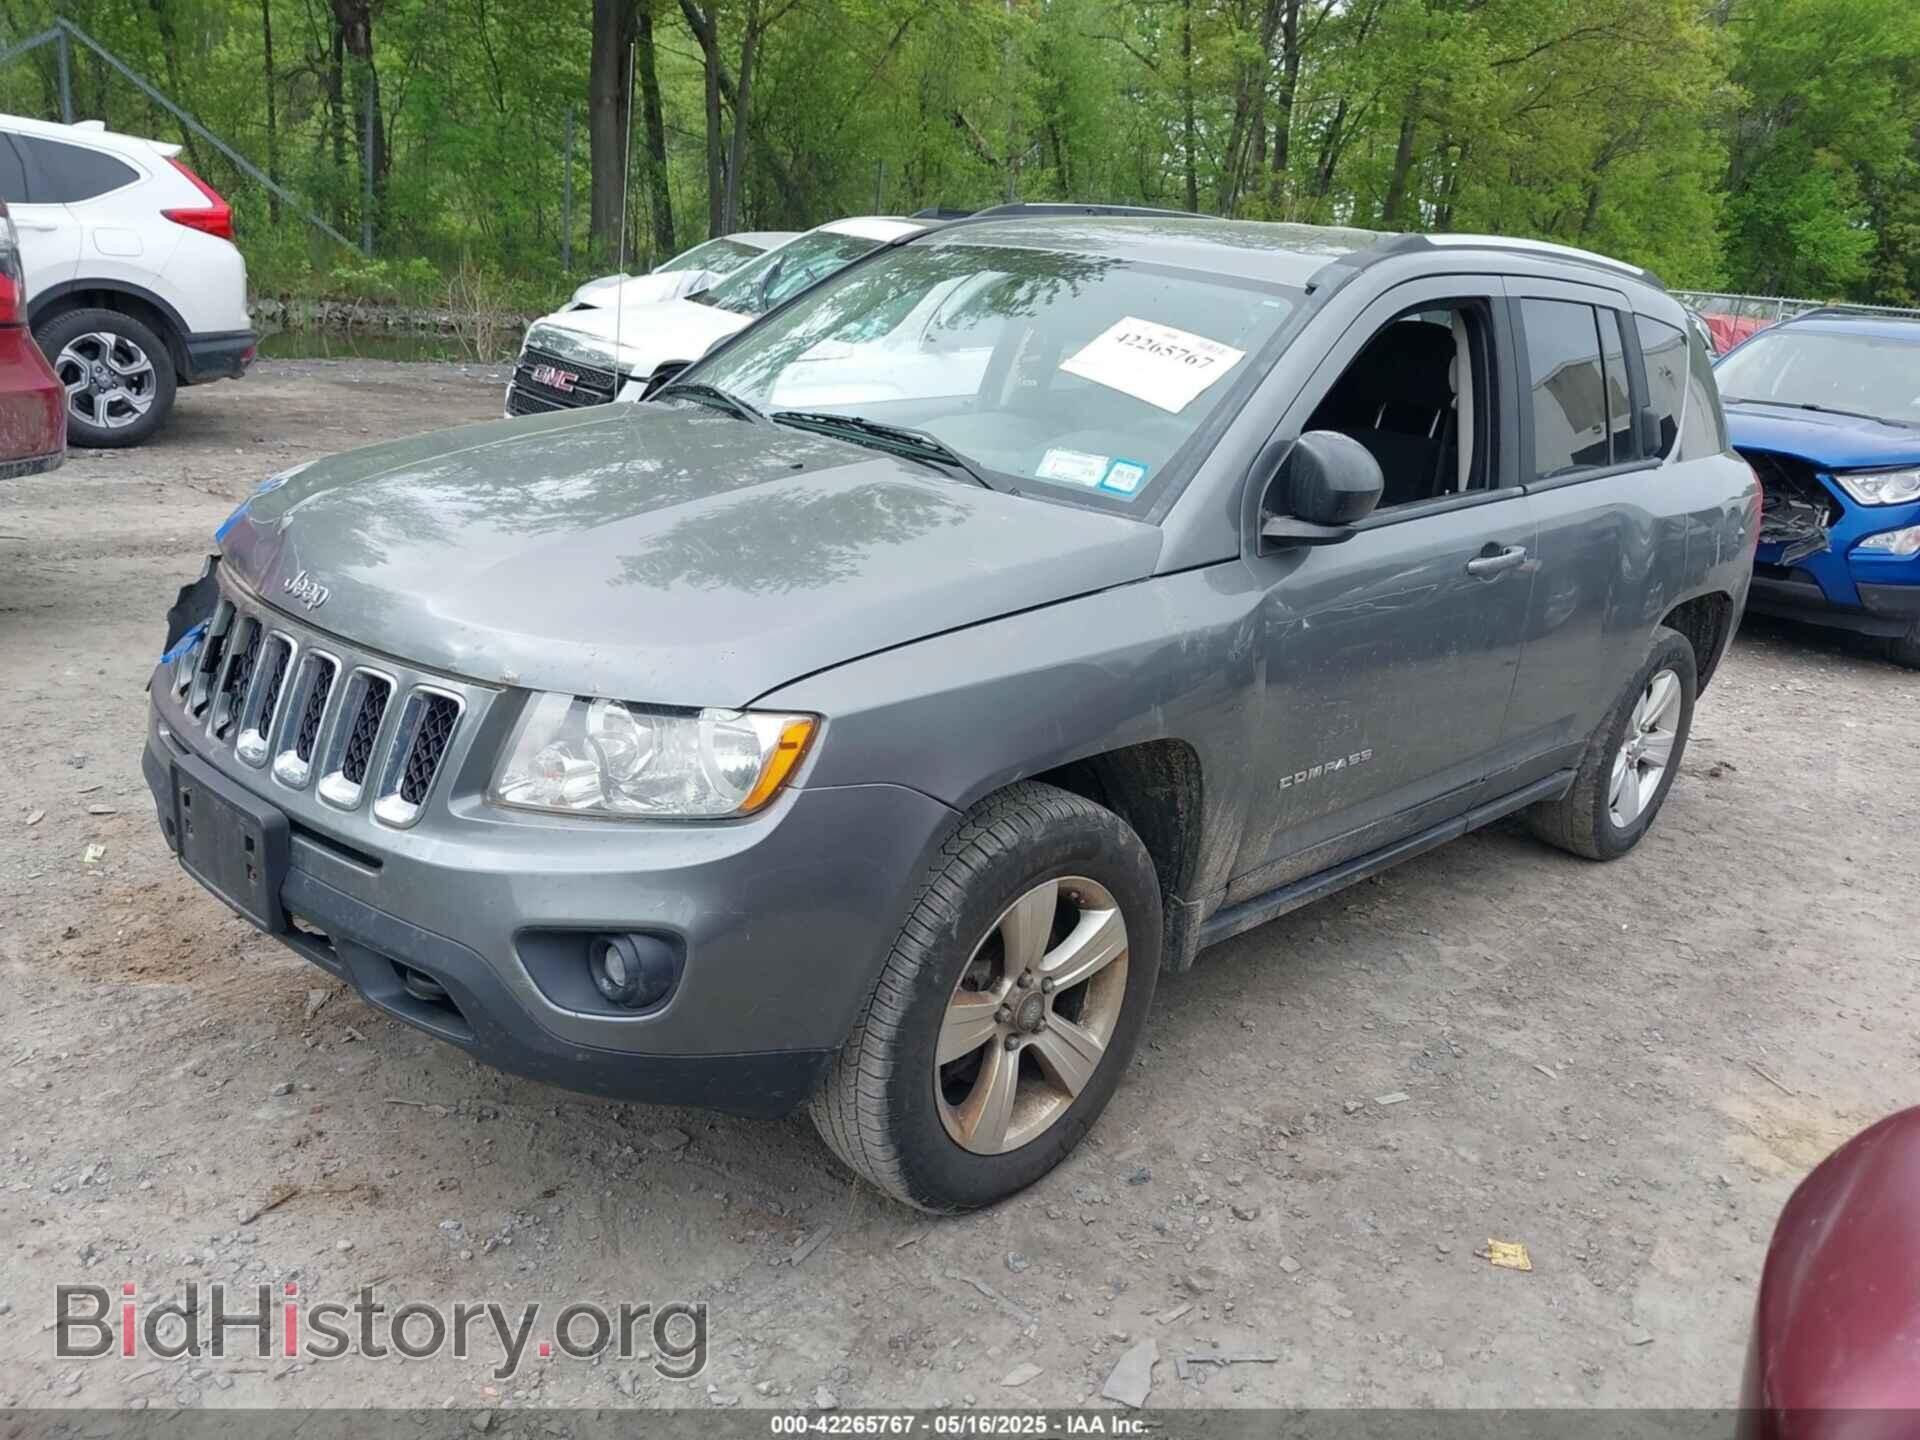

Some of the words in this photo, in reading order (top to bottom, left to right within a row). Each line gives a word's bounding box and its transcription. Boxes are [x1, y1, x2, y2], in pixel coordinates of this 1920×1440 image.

[531, 364, 579, 392] GMC
[284, 570, 329, 611] Jeep
[1279, 748, 1373, 790] COMPASS
